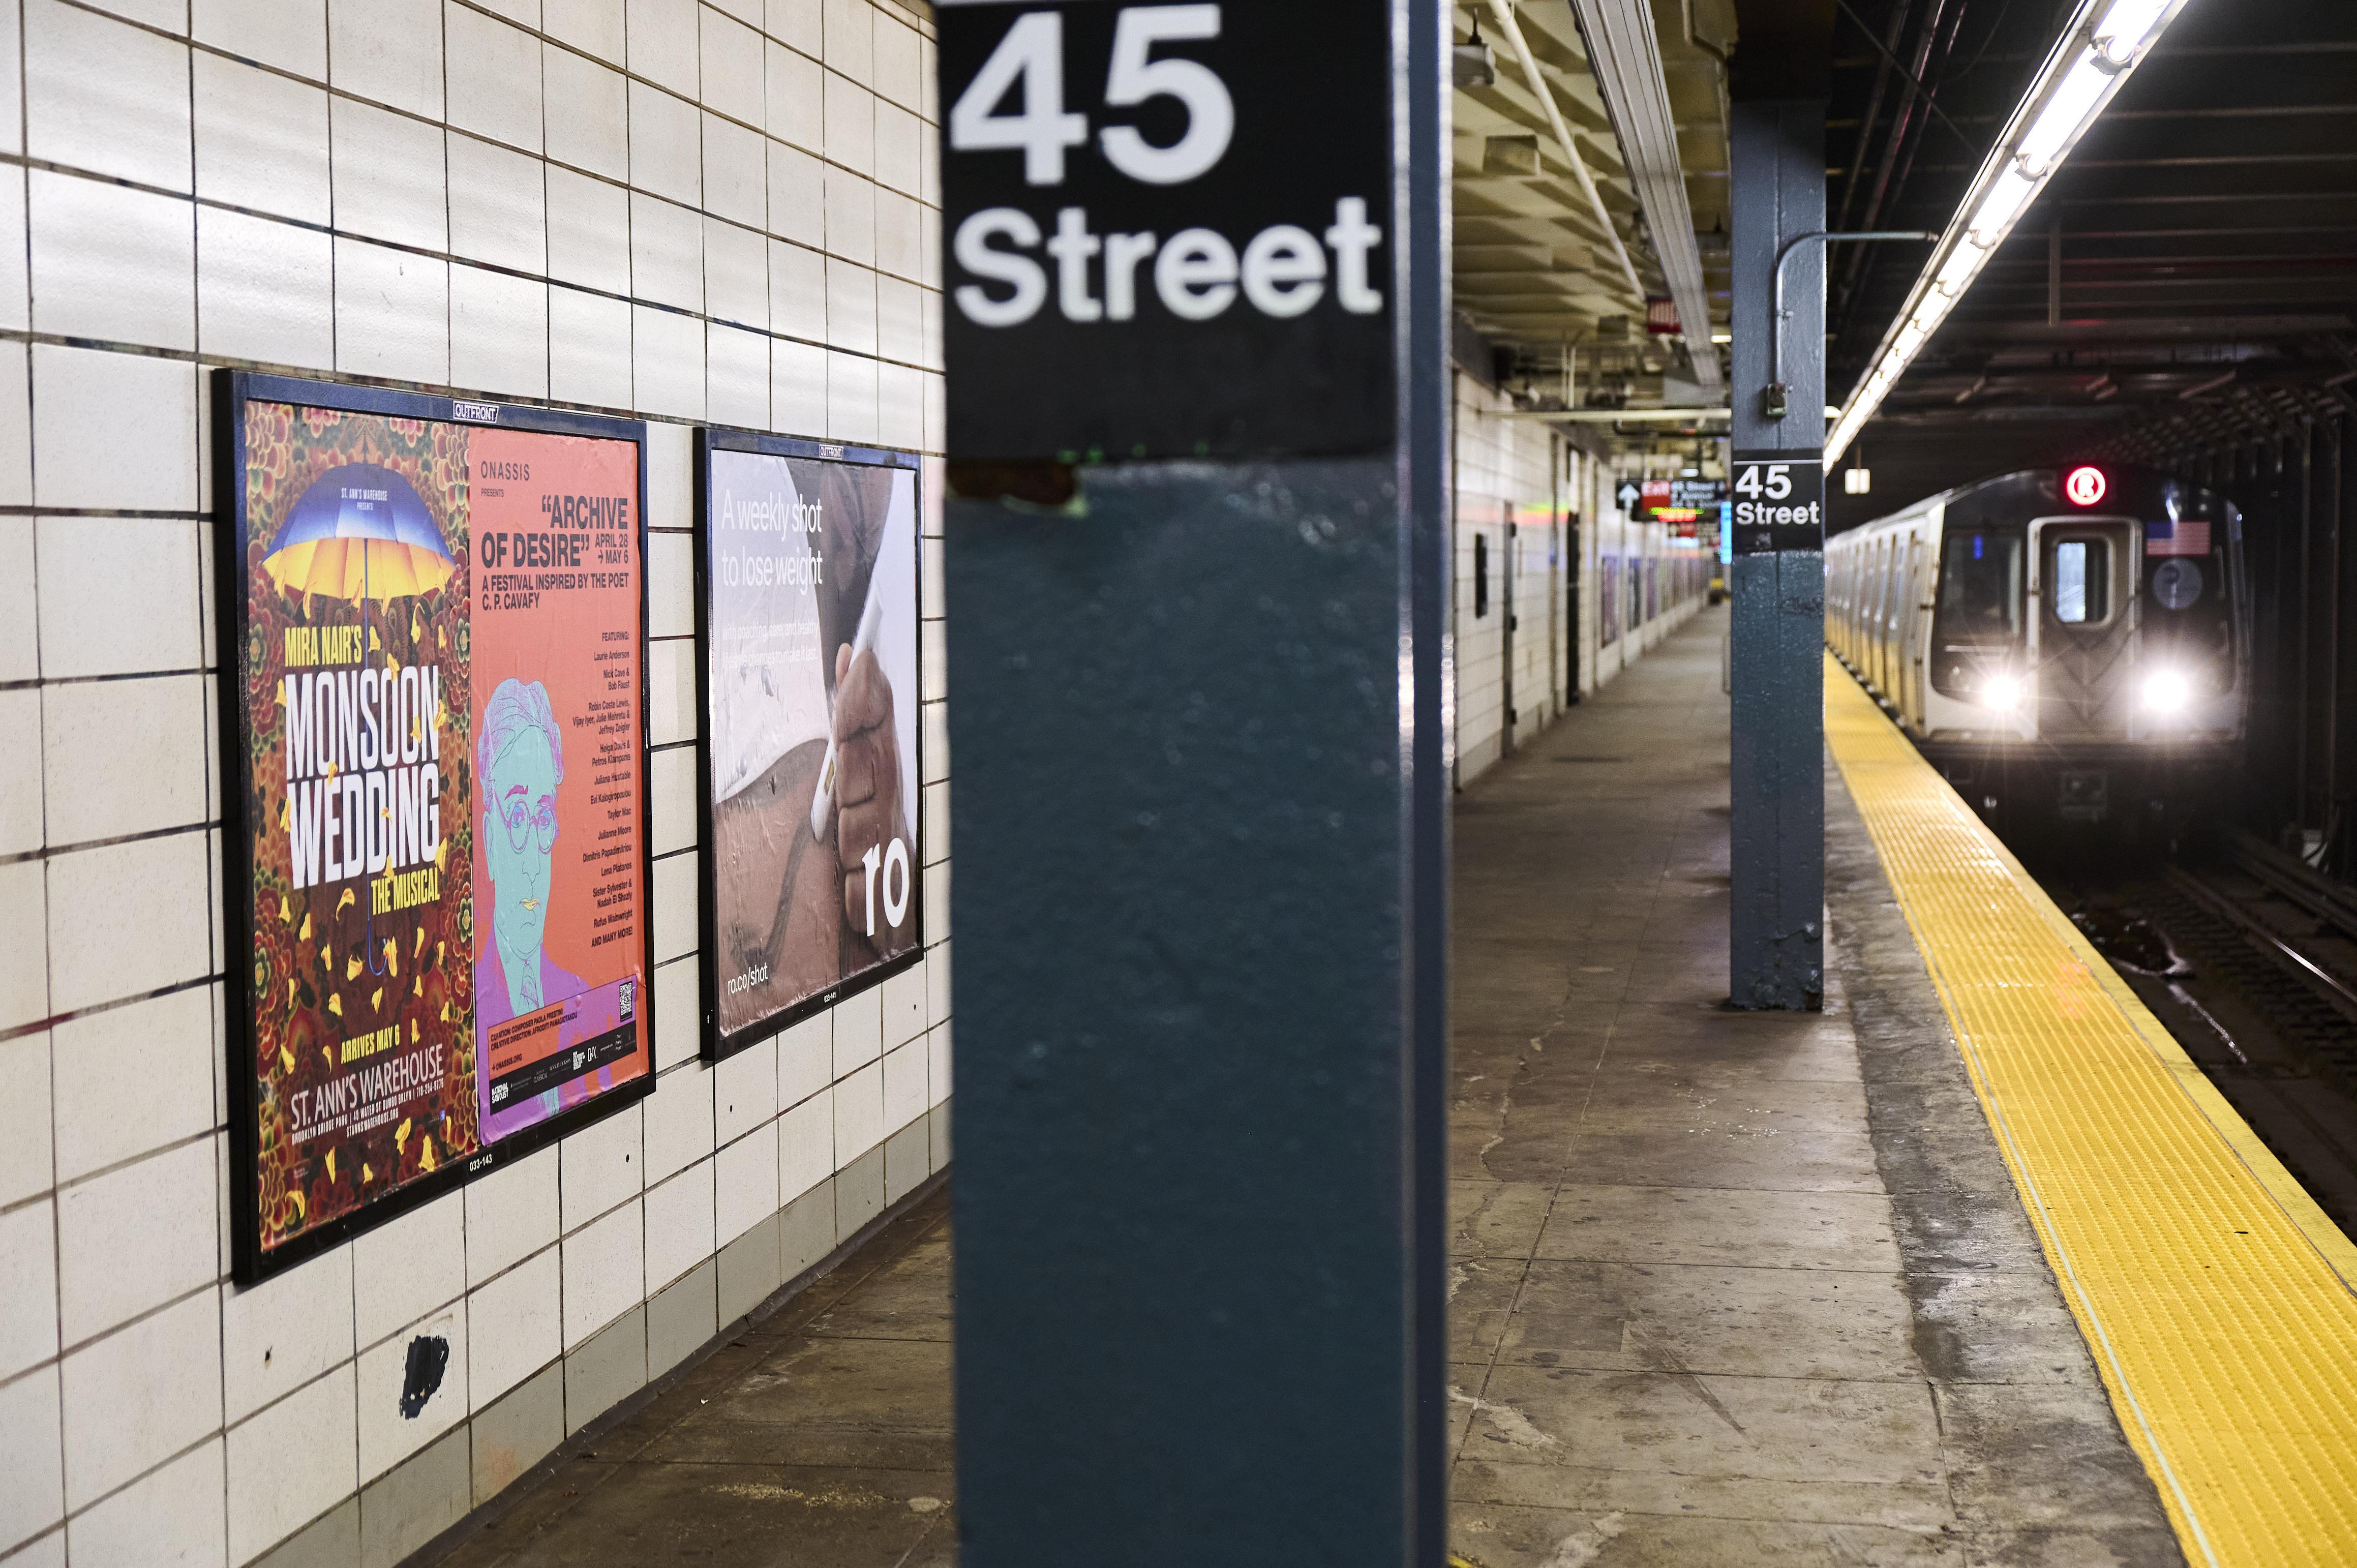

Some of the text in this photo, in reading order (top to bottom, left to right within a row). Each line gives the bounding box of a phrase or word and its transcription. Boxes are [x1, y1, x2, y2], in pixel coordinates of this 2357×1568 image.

[950, 2, 1236, 185] 45
[953, 196, 1383, 327] Street
[455, 403, 496, 421] OUTFRONT
[820, 446, 842, 458] OUTFRONT
[480, 461, 530, 481] ONASSIS
[1735, 465, 1792, 500] 45
[2077, 474, 2095, 497] R
[363, 489, 387, 501] WAREHOUSE
[480, 488, 504, 498] PRESENTS
[721, 489, 822, 541] A weekly shot
[1736, 501, 1820, 525] Street
[481, 532, 507, 568] OF
[595, 534, 628, 548] APRIL 28
[606, 550, 628, 564] MAY 6
[721, 546, 822, 595] to lose weight
[482, 572, 628, 591] A FESTIVAL INSPIRED BY THE POET
[482, 592, 539, 610] C. P. CAVAFY
[602, 631, 629, 641] FEATURING:
[722, 623, 737, 640] with
[785, 619, 797, 636] and
[798, 618, 819, 638] healthy
[285, 625, 362, 667] MIRA NAIR'S
[594, 651, 629, 660] Laurie Anderson
[748, 650, 775, 669] changes
[776, 649, 783, 663] to
[783, 646, 800, 662] make
[801, 645, 805, 660] it
[603, 668, 629, 678] Nick Cave &
[608, 680, 629, 690] Bob Faust
[588, 702, 601, 711] Robin
[602, 701, 615, 710] Coste
[285, 665, 439, 779] MONSOON
[608, 711, 625, 721] Mehretu
[600, 743, 613, 753] Helga
[592, 757, 607, 767] Petros
[594, 771, 630, 785] Juliana Huxtable
[608, 807, 631, 821] Taylor Mac
[287, 763, 439, 890] WEDDING
[598, 826, 631, 840] Julianne Moore
[583, 851, 600, 862] Dimitris
[601, 862, 631, 877] Lena Platonos
[371, 867, 440, 915] THE MUSICAL
[593, 887, 606, 897] Sister
[607, 881, 628, 894] Sylvester
[862, 837, 910, 937] ro
[594, 909, 632, 928] Rufus Wainwright
[591, 926, 632, 948] AND MANY MORE!
[728, 962, 768, 996] ro.co/shot
[511, 1019, 533, 1034] COMPOSER
[534, 1015, 546, 1025] PAOLA
[341, 1024, 400, 1064] ARRIVES MAY 6
[491, 1038, 509, 1051] CREATIVE
[510, 1030, 531, 1043] DIRECTION:
[496, 1053, 522, 1070] ONASSIS.ORG
[291, 1043, 443, 1130] ST. ANN'S WAREHOUSE
[492, 1082, 508, 1096] NATIONAL
[492, 1090, 508, 1104] SAWDUST
[292, 1125, 316, 1145] BROOKLYN
[318, 1119, 334, 1136] BRIDGE
[336, 1114, 347, 1128] PARK
[360, 1104, 374, 1119] WATER
[376, 1101, 381, 1113] ST
[383, 1095, 397, 1111] DUMBO
[398, 1090, 411, 1104] BKLYN
[346, 1107, 399, 1138] STANNSWAREHOUSE.ORG
[470, 1154, 492, 1171] 033-143
